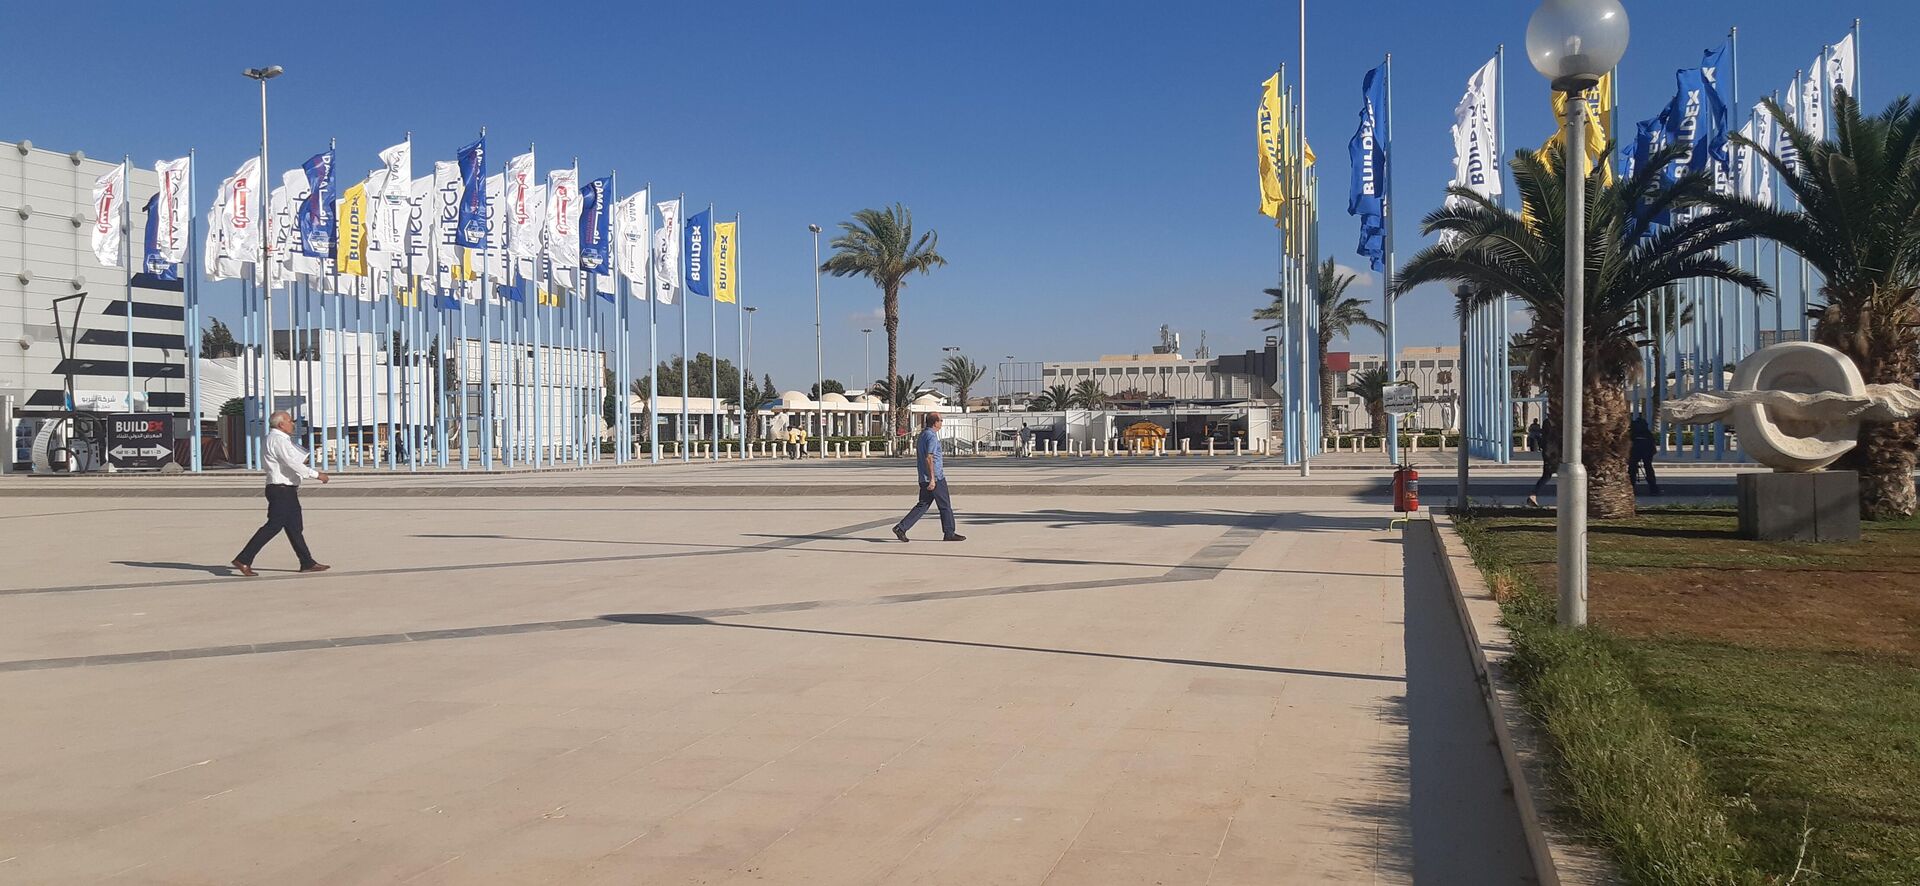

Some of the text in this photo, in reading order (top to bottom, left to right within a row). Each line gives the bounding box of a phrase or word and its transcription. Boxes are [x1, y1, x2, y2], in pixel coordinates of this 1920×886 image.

[1469, 103, 1485, 185] BUILDEX
[1674, 89, 1700, 178] BULDEX
[170, 169, 183, 250] RASSAN
[350, 193, 360, 261] BUILDEX
[691, 226, 702, 281] BUILDEX
[719, 235, 728, 289] BUILDEX
[116, 421, 164, 432] BUILDEX
